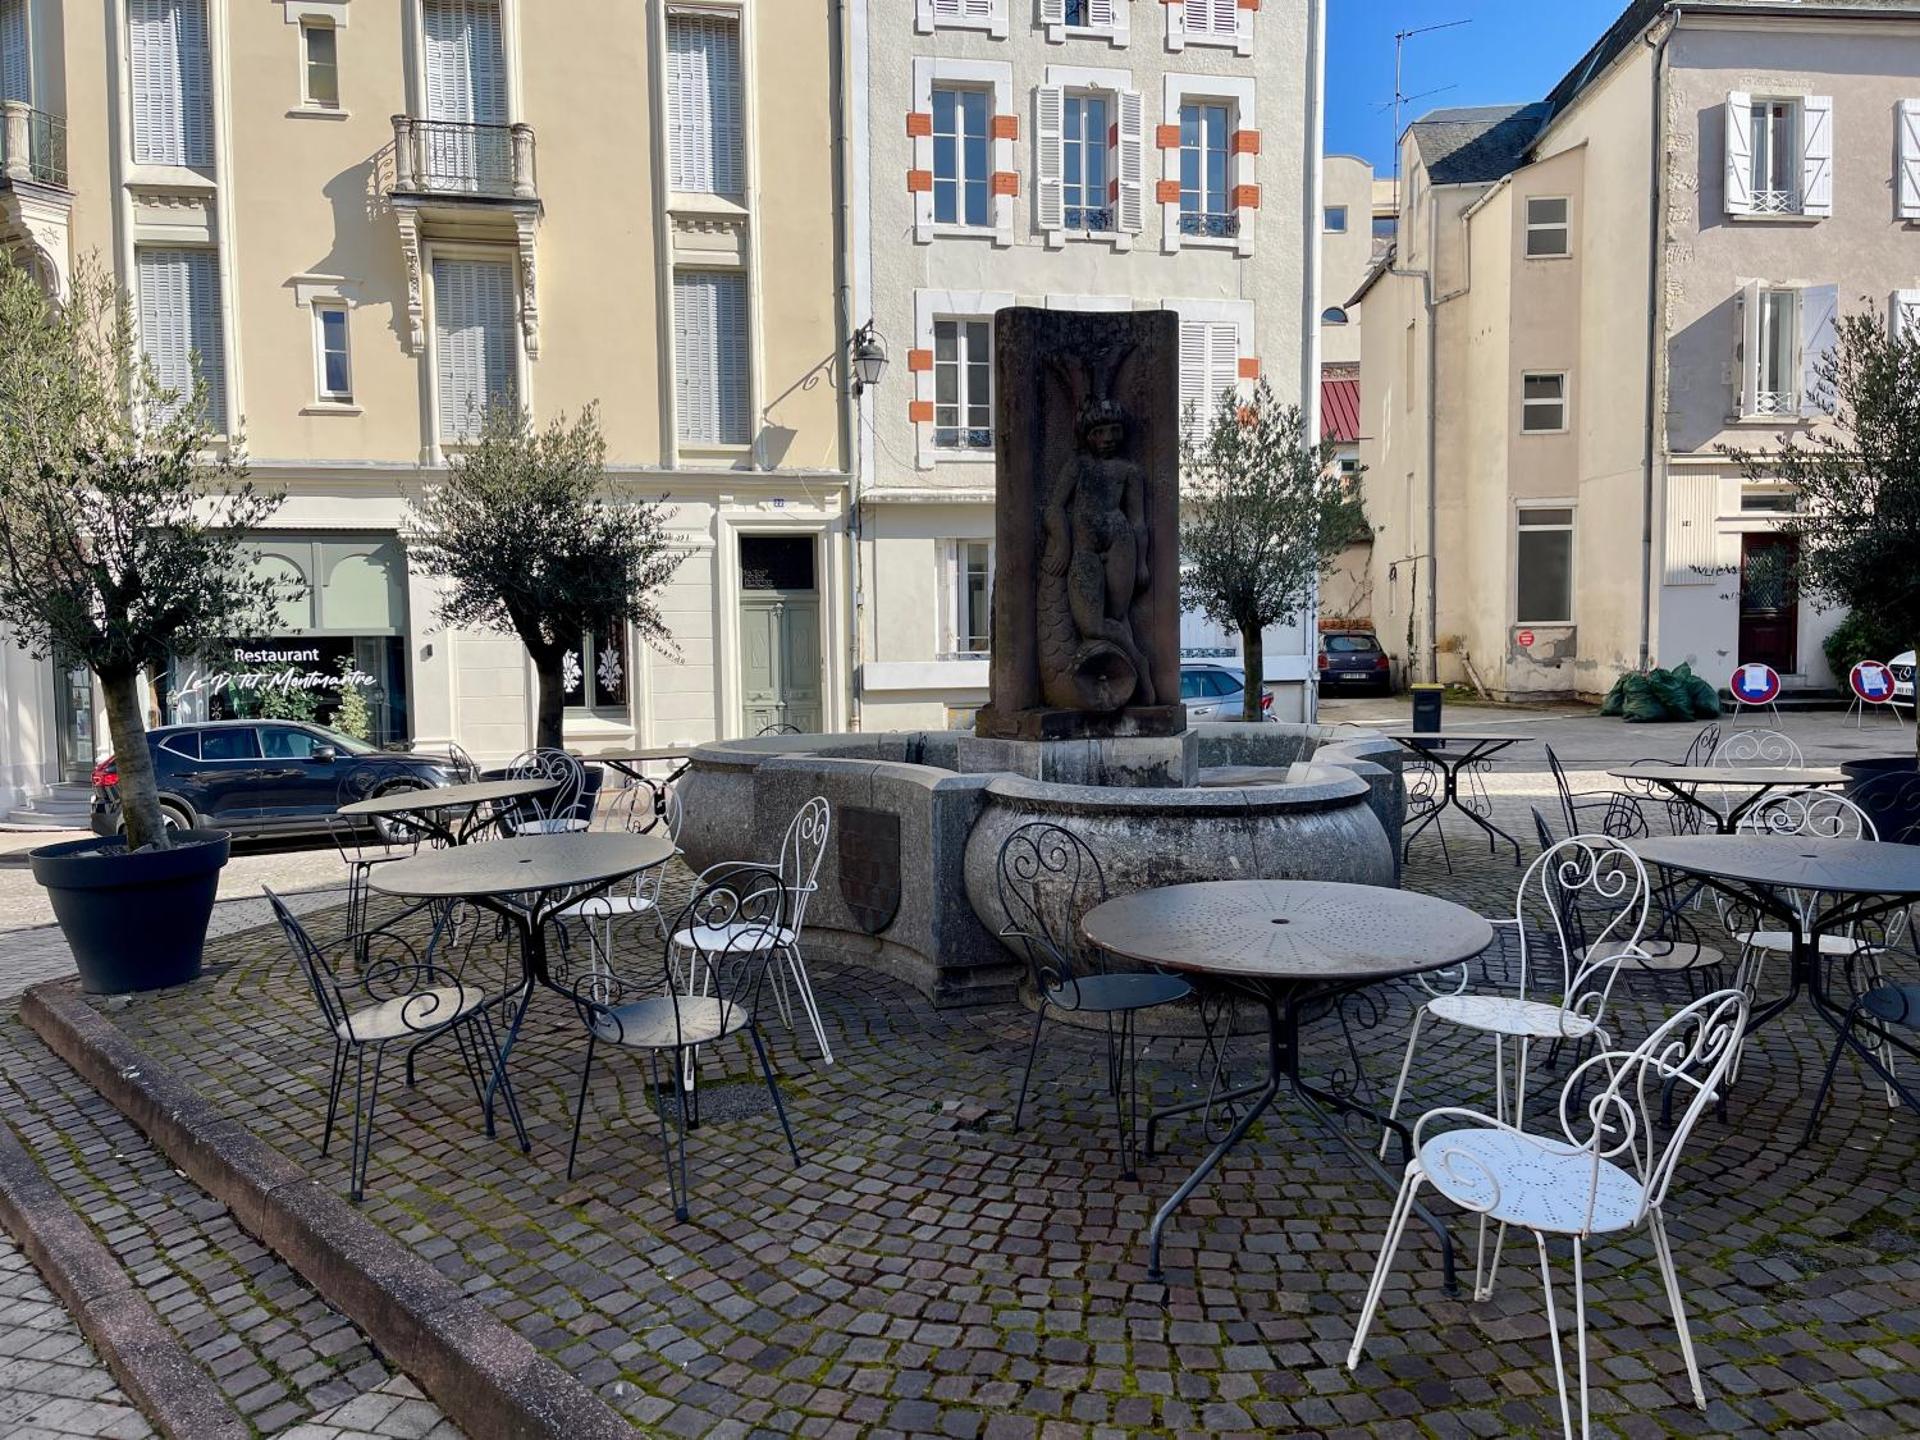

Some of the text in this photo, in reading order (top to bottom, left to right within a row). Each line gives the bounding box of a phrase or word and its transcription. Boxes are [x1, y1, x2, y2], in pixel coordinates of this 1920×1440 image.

[234, 649, 320, 662] Restaurant
[178, 666, 377, 696] Le P'tit Montmartre
